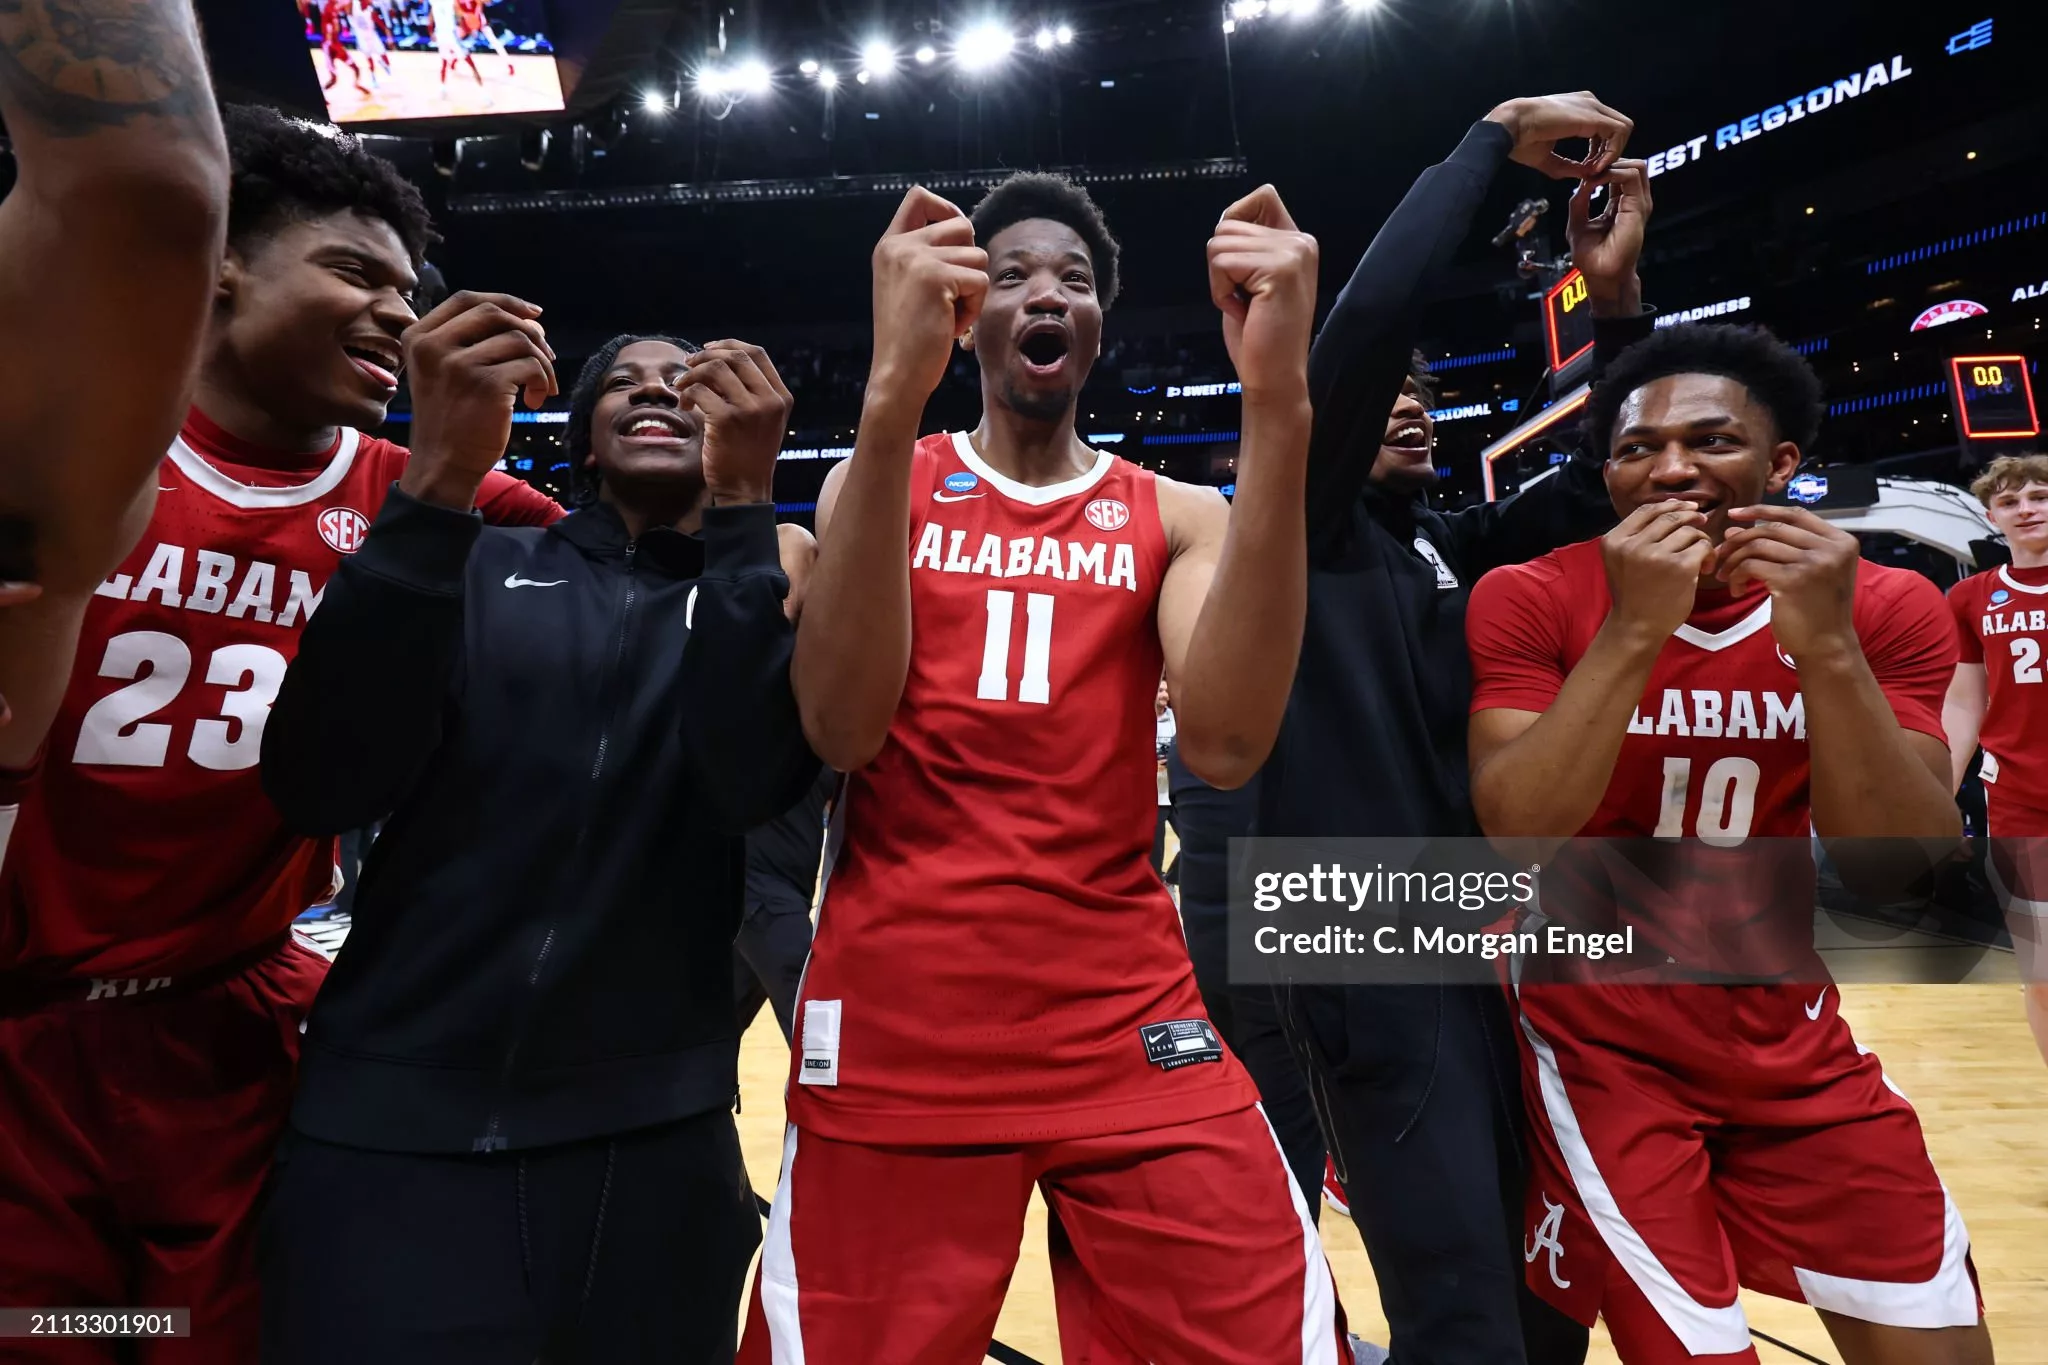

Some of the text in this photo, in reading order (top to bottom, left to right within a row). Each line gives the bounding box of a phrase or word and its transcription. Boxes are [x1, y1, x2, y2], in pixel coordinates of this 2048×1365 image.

[1642, 55, 1912, 178] EST REGIONAL
[1182, 384, 1226, 397] SWEET
[1973, 366, 2003, 386] 0.0
[820, 447, 855, 458] CRIM
[948, 479, 976, 488] NCAA
[322, 509, 370, 552] SEC
[1089, 499, 1126, 529] SEC
[912, 521, 1137, 592] ALABAMA
[976, 589, 1055, 705] 11
[2009, 637, 2048, 684] 2
[72, 630, 288, 771] 23
[1653, 756, 1761, 848] 10
